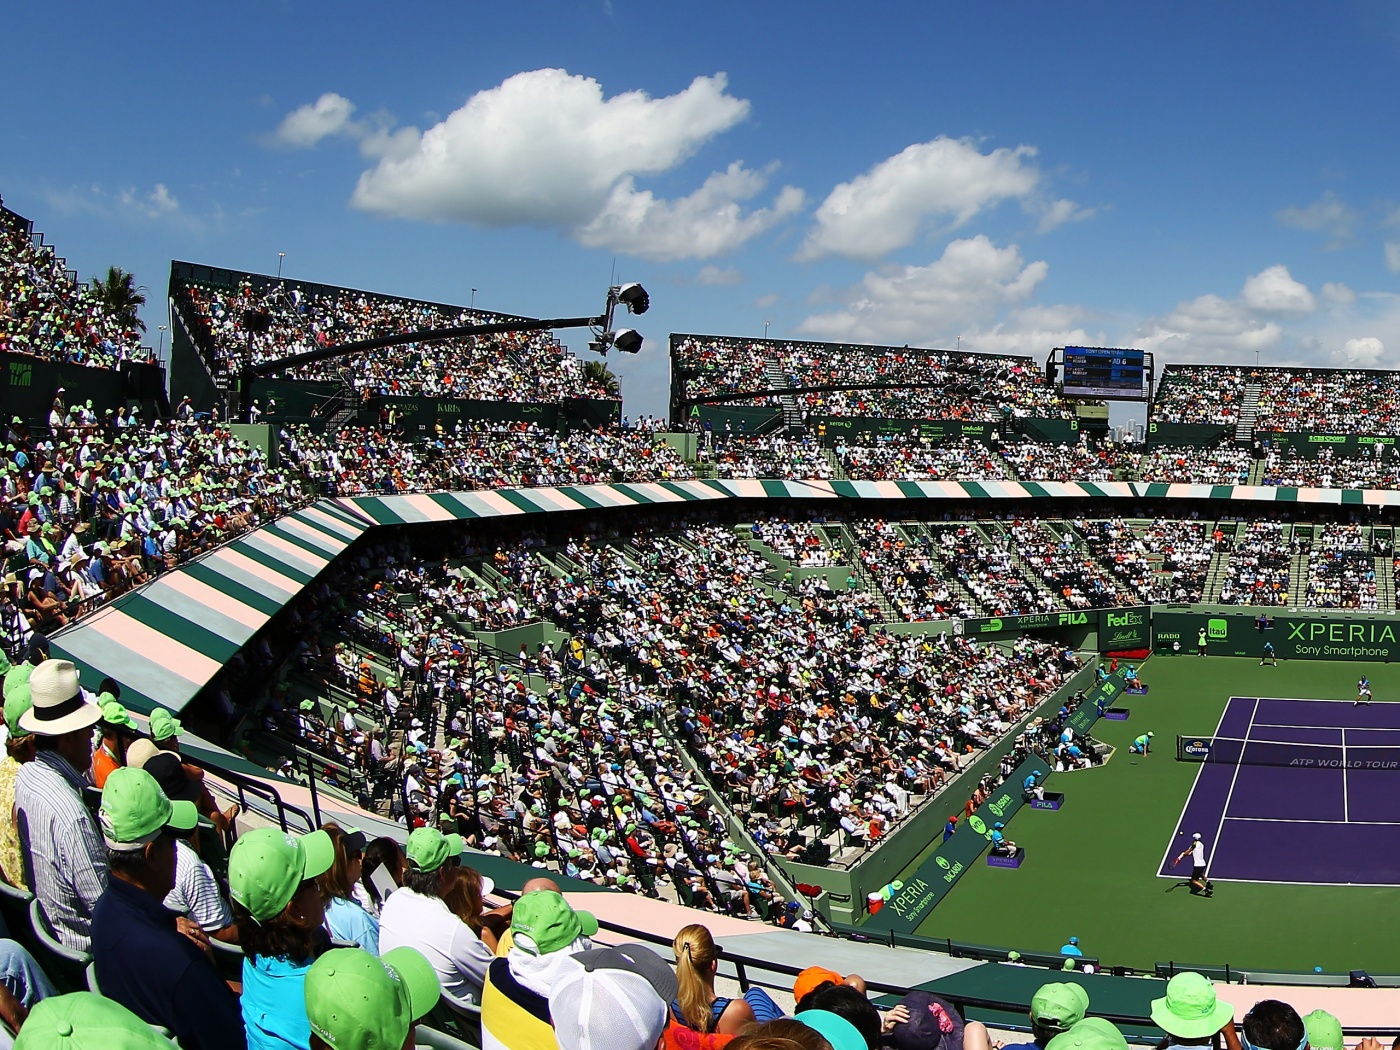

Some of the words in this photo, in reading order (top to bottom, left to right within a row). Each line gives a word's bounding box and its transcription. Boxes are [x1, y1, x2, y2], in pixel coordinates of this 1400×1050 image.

[613, 402, 620, 414] A
[690, 405, 700, 417] A
[1071, 421, 1078, 430] B
[1149, 424, 1157, 433] B
[1017, 615, 1050, 625] XPERIA
[1059, 612, 1088, 626] FILA
[1107, 612, 1143, 627] FedEx
[1287, 622, 1397, 643] XPERIA
[1295, 644, 1321, 656] Sony
[1323, 645, 1389, 657] Smartphone
[1185, 745, 1209, 754] Corona
[1290, 758, 1314, 766] ATP
[1318, 759, 1362, 768] WORLD
[1037, 801, 1054, 809] FILA
[889, 878, 929, 917] XPERIA
[905, 908, 919, 922] Sony
[912, 891, 935, 914] Smartphone
